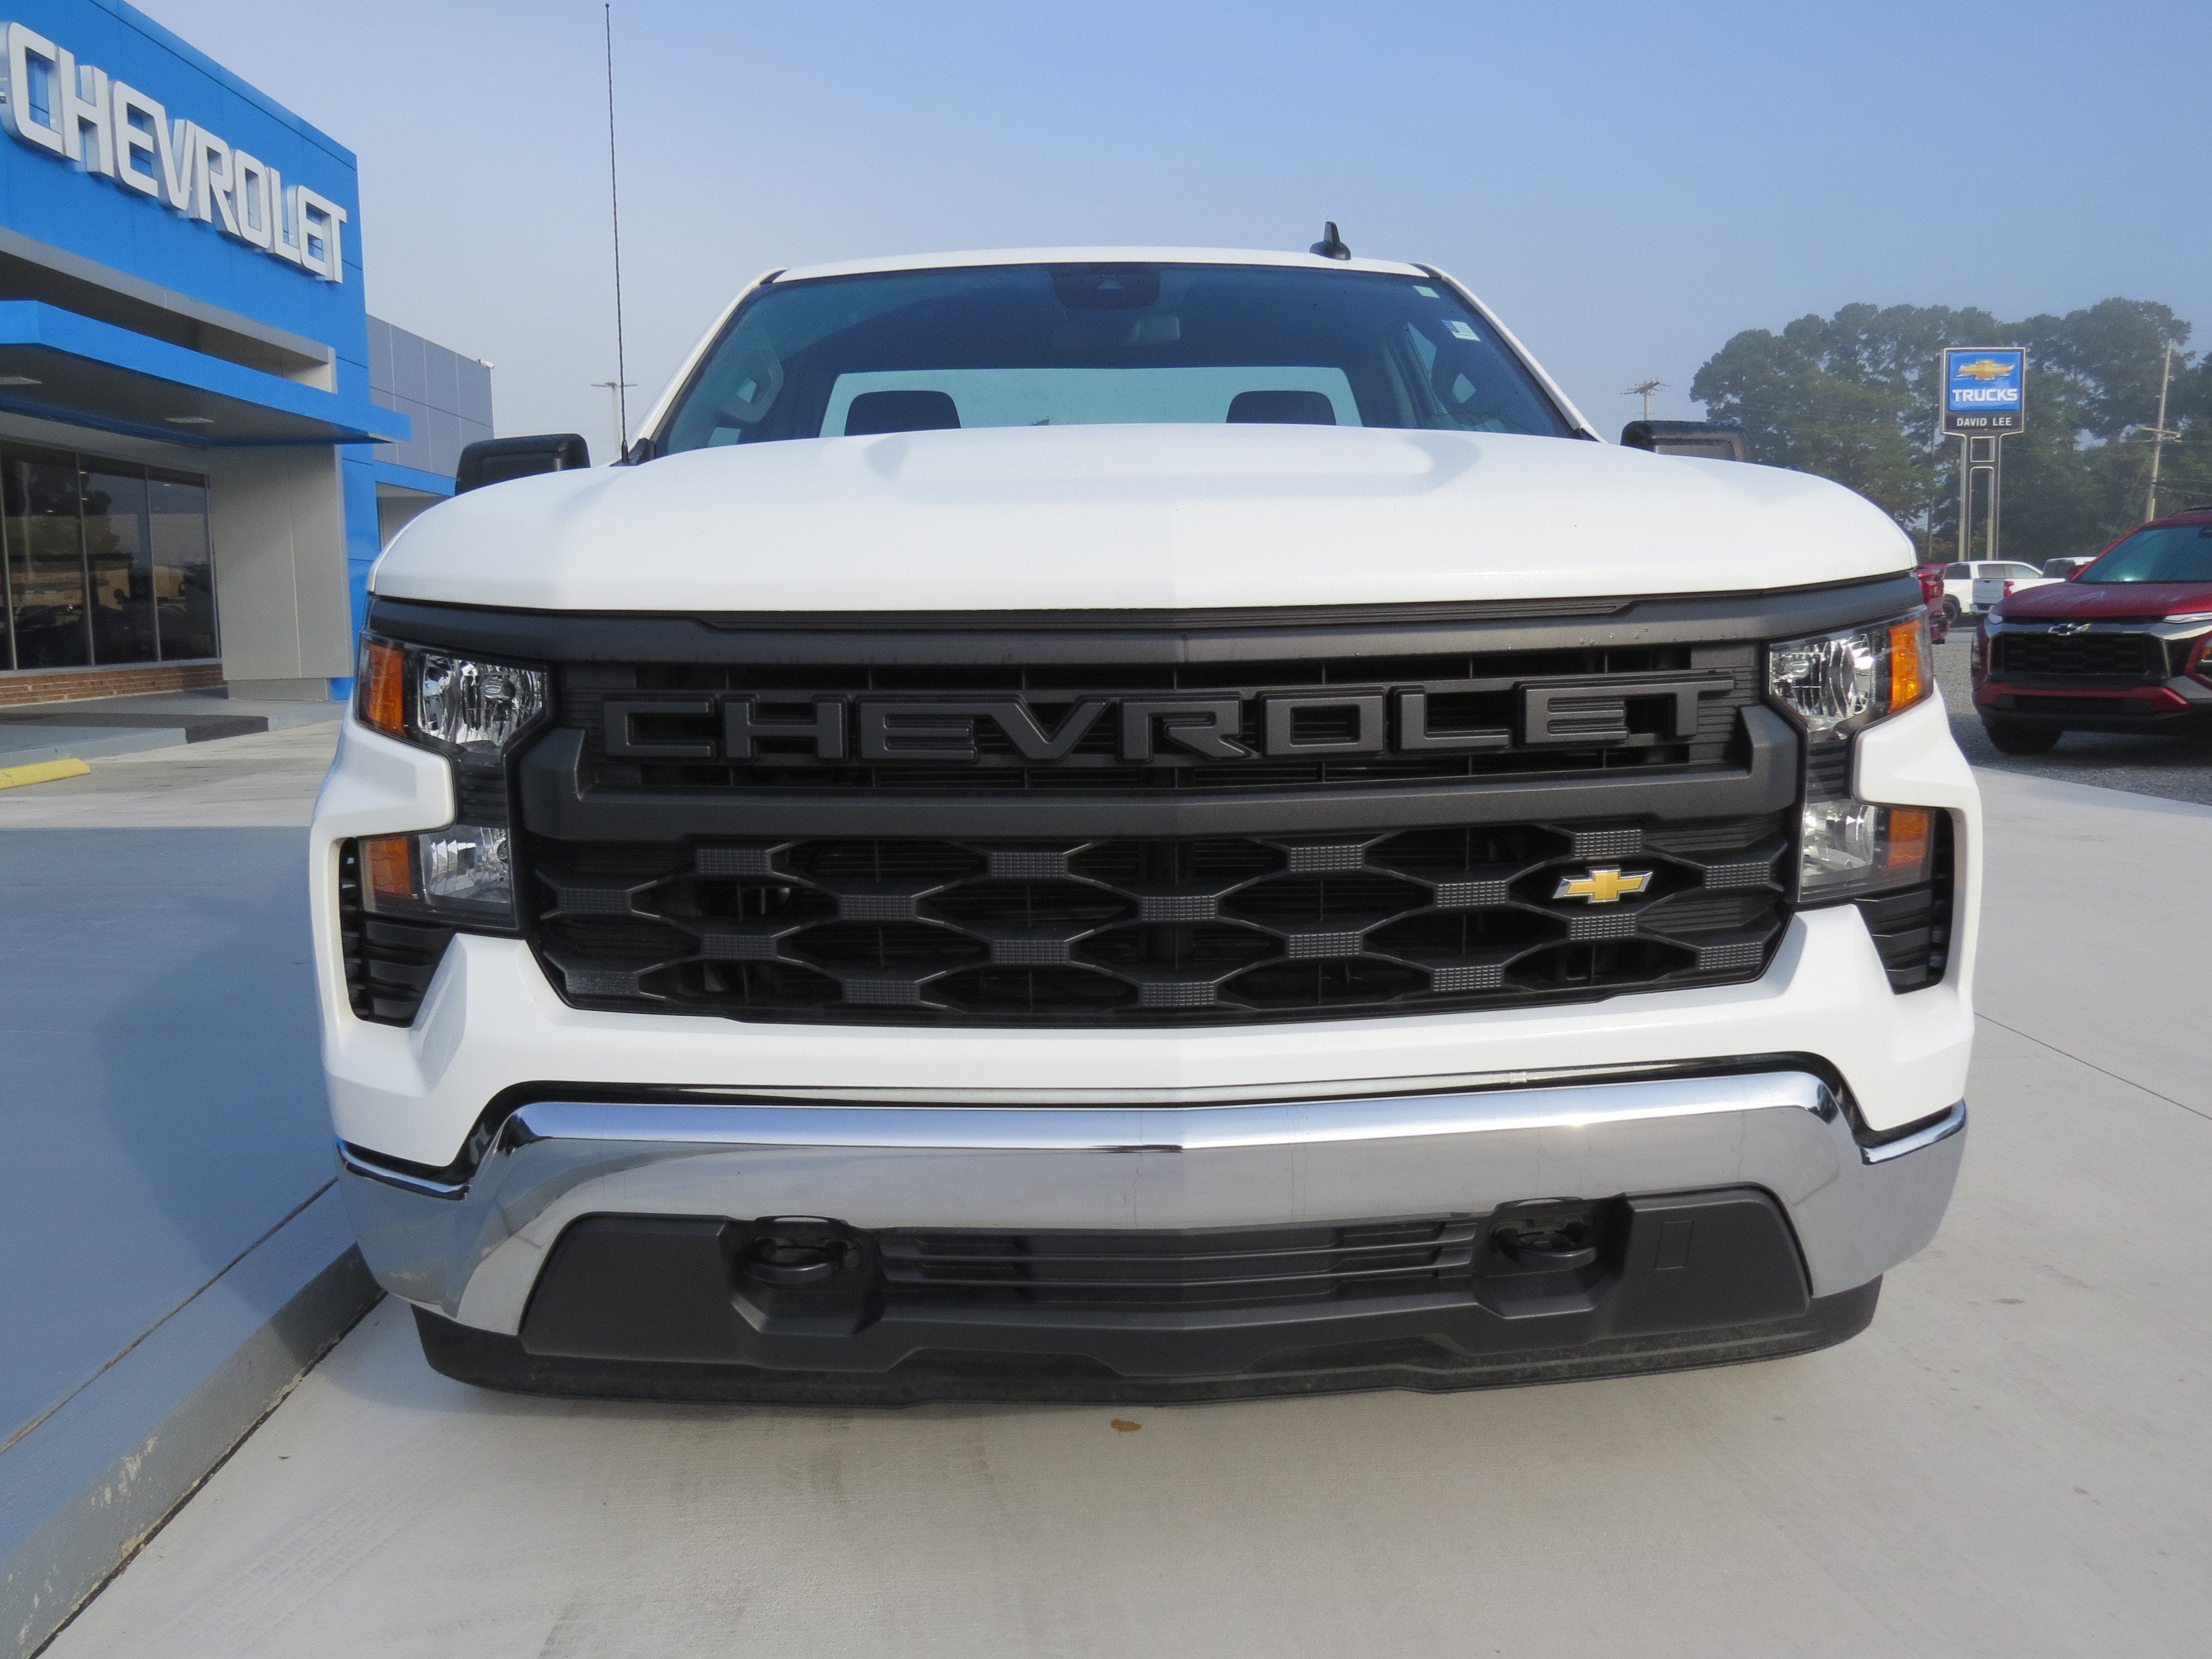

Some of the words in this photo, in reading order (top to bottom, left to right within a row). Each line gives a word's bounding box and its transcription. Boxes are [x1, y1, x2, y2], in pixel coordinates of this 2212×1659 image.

[6, 21, 347, 284] CHEVROLET
[1952, 389, 2018, 401] TRUCKS
[1957, 418, 1987, 426] DAVID
[1992, 418, 2012, 426] LEE
[603, 672, 1735, 763] CHEVROLET
